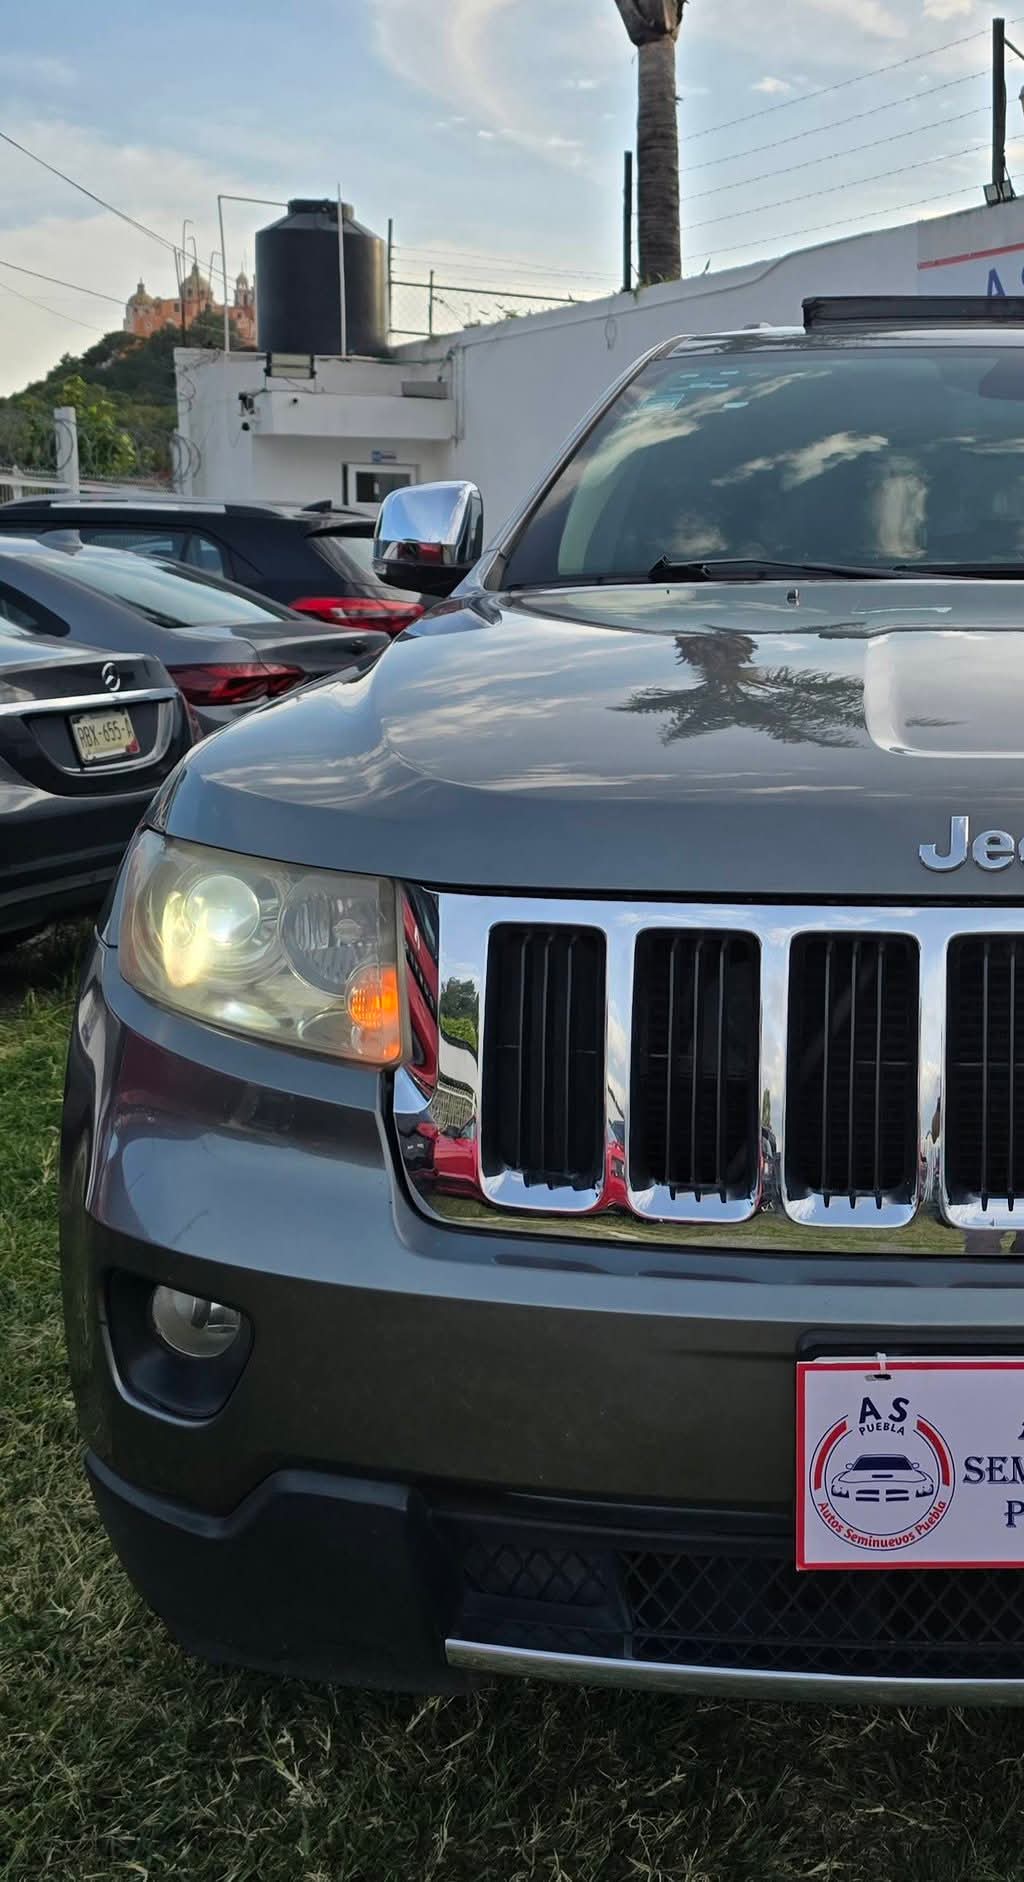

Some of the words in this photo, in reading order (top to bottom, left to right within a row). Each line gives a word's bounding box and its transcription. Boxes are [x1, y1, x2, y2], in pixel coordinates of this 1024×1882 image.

[859, 1422, 905, 1436] PUEBLA
[817, 1502, 844, 1533] Autos
[843, 1528, 916, 1549] Seminuevos
[915, 1501, 947, 1536] Puebla
